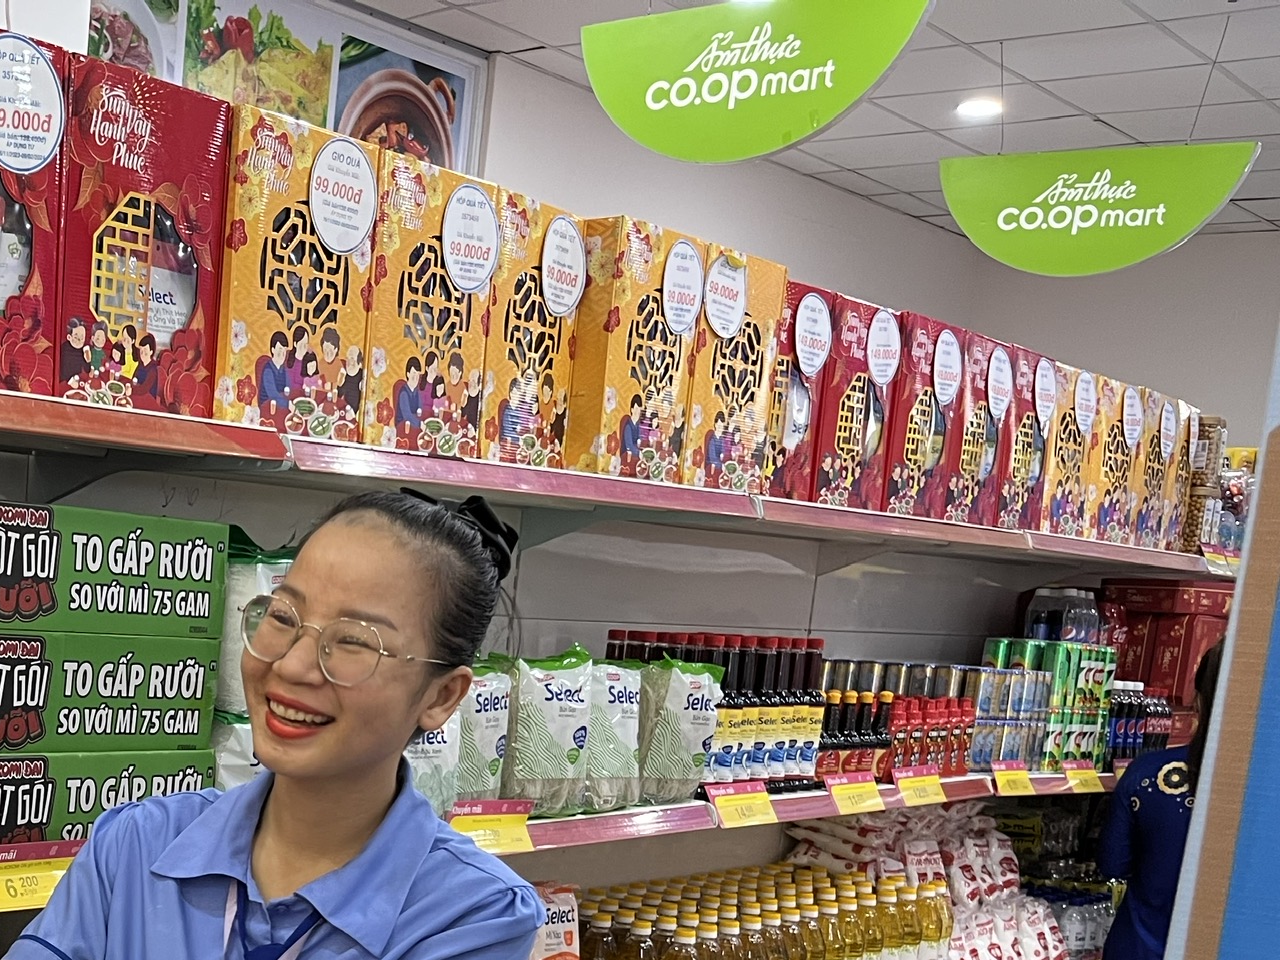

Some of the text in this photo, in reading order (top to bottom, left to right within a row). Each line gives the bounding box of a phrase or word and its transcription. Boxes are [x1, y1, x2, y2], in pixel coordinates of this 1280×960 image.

[736, 21, 802, 66] thực
[346, 155, 362, 170] QUÀ
[314, 175, 364, 205] 99.000đ
[1080, 168, 1137, 202] thực
[449, 240, 491, 262] 99.000đ
[546, 264, 579, 288] 99.000đ
[28, 508, 50, 528] ĐẠI
[22, 529, 58, 579] GÓI
[72, 528, 213, 582] TO GẤP RƯỠI
[70, 580, 210, 618] SO VỚI MÌ 75 GAM
[20, 640, 41, 660] ĐẠI
[13, 660, 49, 708] GÓI
[63, 653, 205, 699] TO GẤP RƯỠI
[474, 692, 510, 714] Select
[57, 703, 199, 735] SO VỚI MÌ 75 GAM
[22, 760, 44, 779] ĐẠI
[16, 778, 53, 825] GÓI
[66, 764, 146, 814] TO GẤP
[0, 850, 17, 862] mãi
[544, 906, 576, 926] Select
